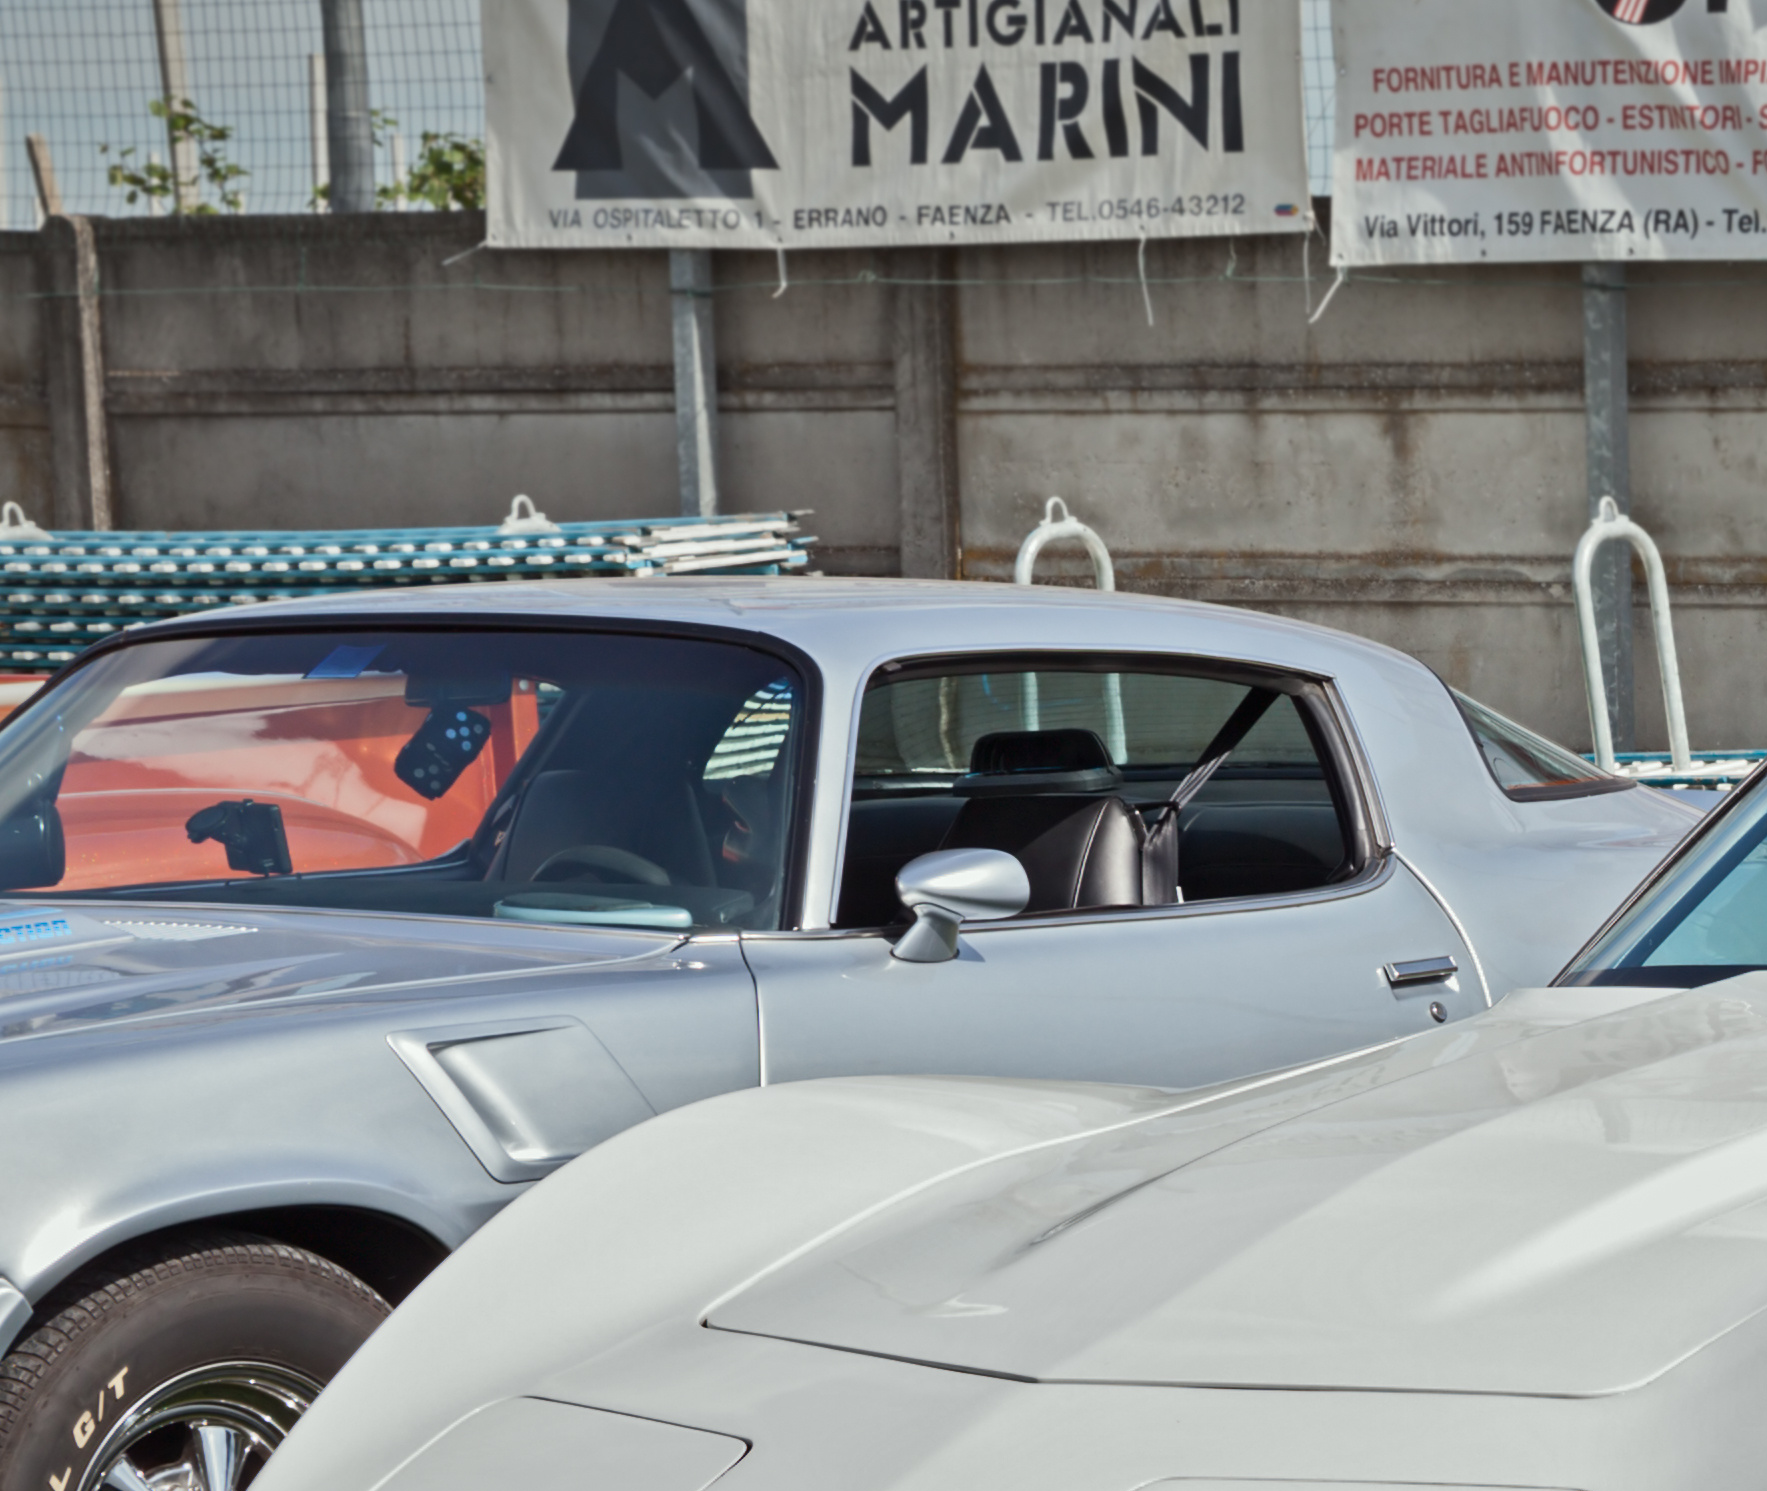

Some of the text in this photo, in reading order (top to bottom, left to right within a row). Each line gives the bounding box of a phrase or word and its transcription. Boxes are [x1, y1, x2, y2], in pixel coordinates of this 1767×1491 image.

[848, 0, 1240, 51] ARTIGIANALI
[1372, 63, 1504, 94] FORNITURA
[1509, 62, 1521, 88] E
[1526, 60, 1716, 87] MANUTENZIONE
[849, 51, 1244, 167] MARINI
[1354, 111, 1433, 139] PORTE
[1438, 106, 1600, 136] TAGLIAFUOCO
[1622, 105, 1743, 131] ESTINTORI
[1355, 153, 1489, 183] MATERIALE
[1494, 149, 1730, 179] ANTINFORTUNISTICO
[549, 207, 583, 230] VIA
[592, 207, 741, 230] OSPITALETTO
[753, 209, 763, 230] 1
[793, 205, 888, 230] ERRANO
[917, 204, 1012, 227] FAENZA
[1363, 214, 1399, 240] Via
[1406, 211, 1487, 241] Vittori,
[1493, 212, 1534, 237] 159
[1539, 209, 1636, 236] FAENZA
[1642, 208, 1700, 241] (RA)
[72, 1366, 130, 1450] G/T
